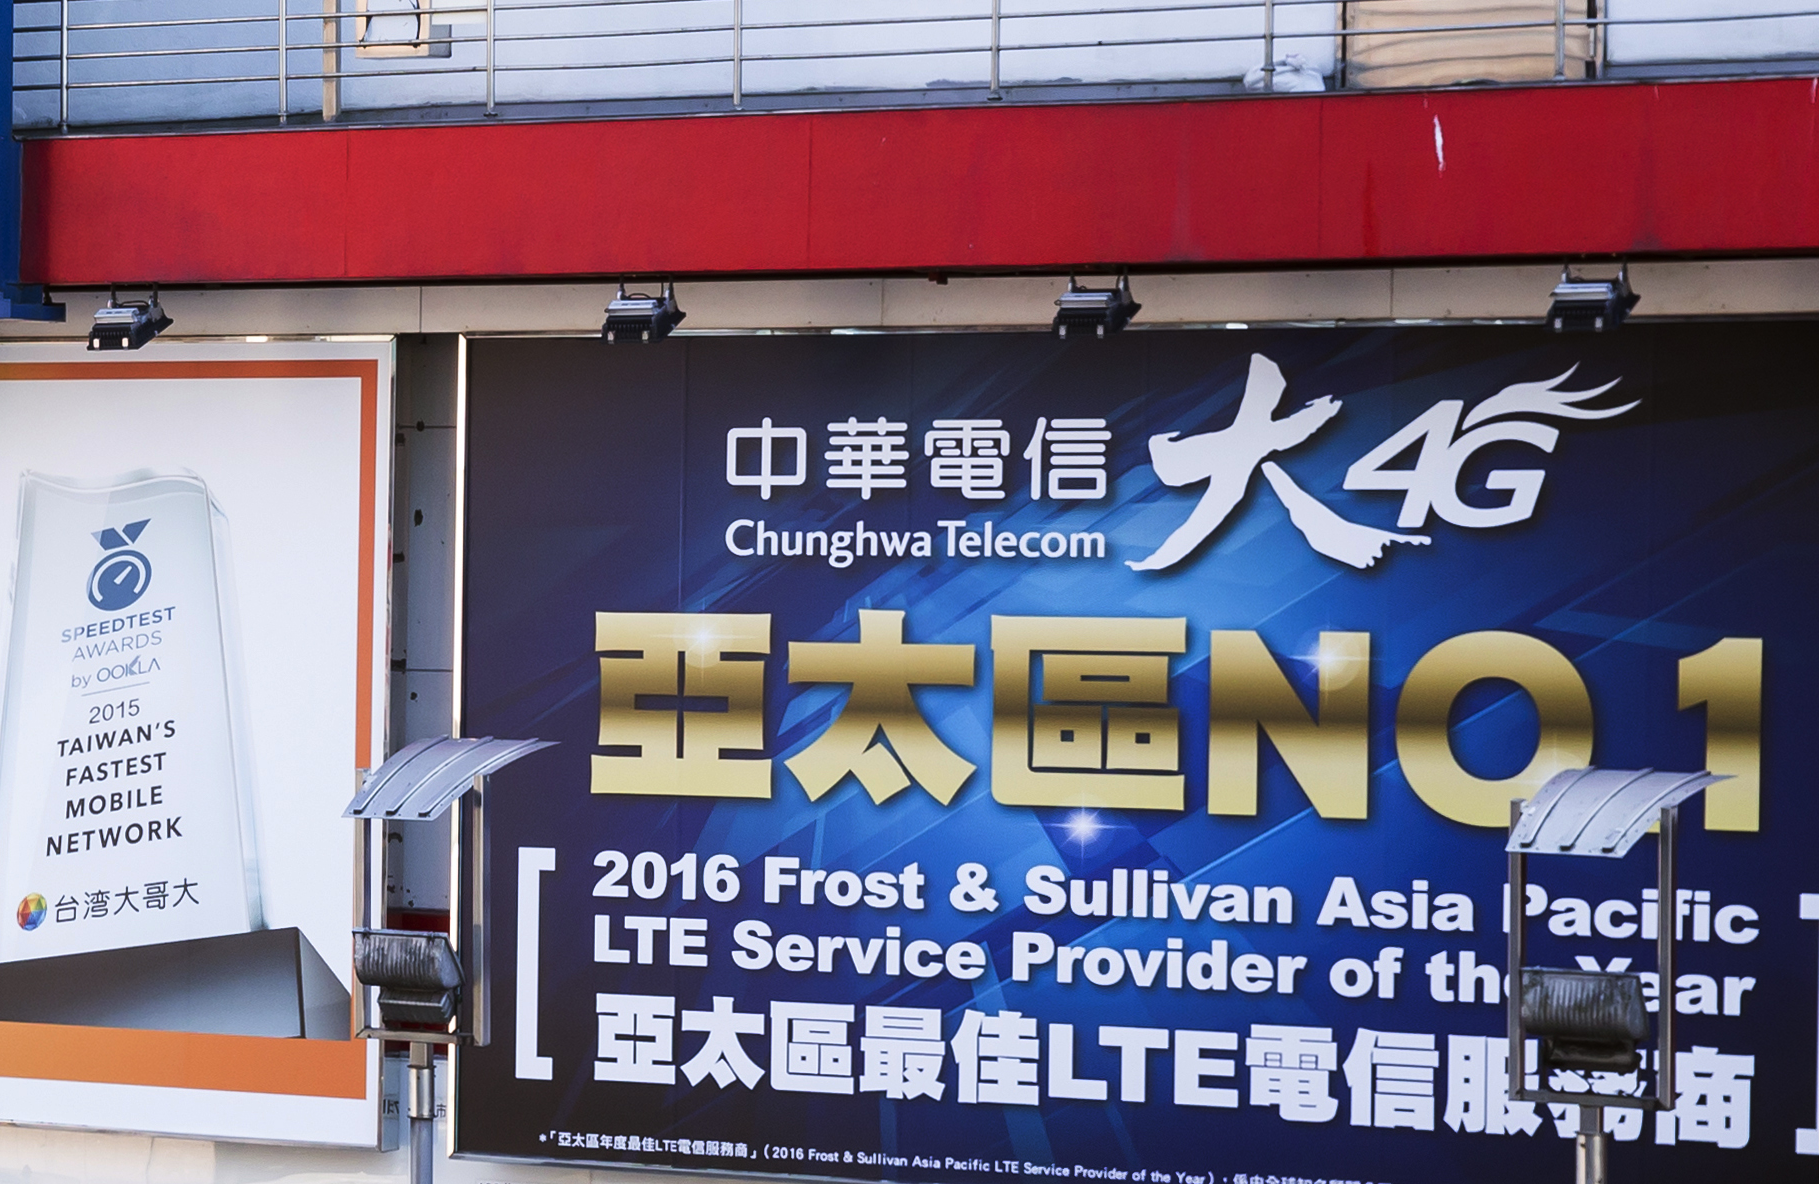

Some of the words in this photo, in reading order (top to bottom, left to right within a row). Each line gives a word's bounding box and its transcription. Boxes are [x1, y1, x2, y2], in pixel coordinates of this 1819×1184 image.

[725, 416, 1112, 500] 中華電信
[724, 518, 933, 568] Chunghwa
[936, 520, 1107, 559] Telecom
[60, 606, 177, 644] SPEEDTEST
[71, 630, 163, 663] AWARDS
[70, 671, 94, 692] by
[96, 656, 162, 684] OOKLA
[88, 699, 141, 725] 2015
[590, 609, 1763, 834] 亞太區NO1
[57, 720, 177, 758] TAIWAN'S
[65, 751, 167, 787] FASTEST
[65, 784, 164, 820] MOBILE
[46, 815, 184, 858] NETWORK
[592, 850, 741, 903] 2016
[763, 856, 926, 910] Frost
[948, 862, 1000, 913] &
[1023, 865, 1292, 924] Sullivan
[1316, 876, 1475, 934] Asia
[1502, 883, 1760, 945] Pacific
[593, 914, 709, 967] LTE
[731, 920, 986, 980] Service
[1011, 932, 1307, 996] Provider
[1328, 946, 1404, 999] of
[1425, 950, 1515, 1005] th
[808, 1148, 840, 1164] Frost
[843, 1150, 854, 1164] &
[857, 1151, 908, 1168] Sullivan
[912, 1155, 941, 1170] Asia
[944, 1156, 990, 1172] Pacific
[994, 1159, 1020, 1174] LTE
[1023, 1161, 1070, 1178] Service
[1074, 1164, 1128, 1181] Provider
[1132, 1169, 1147, 1182] of
[1150, 1169, 1171, 1184] the
